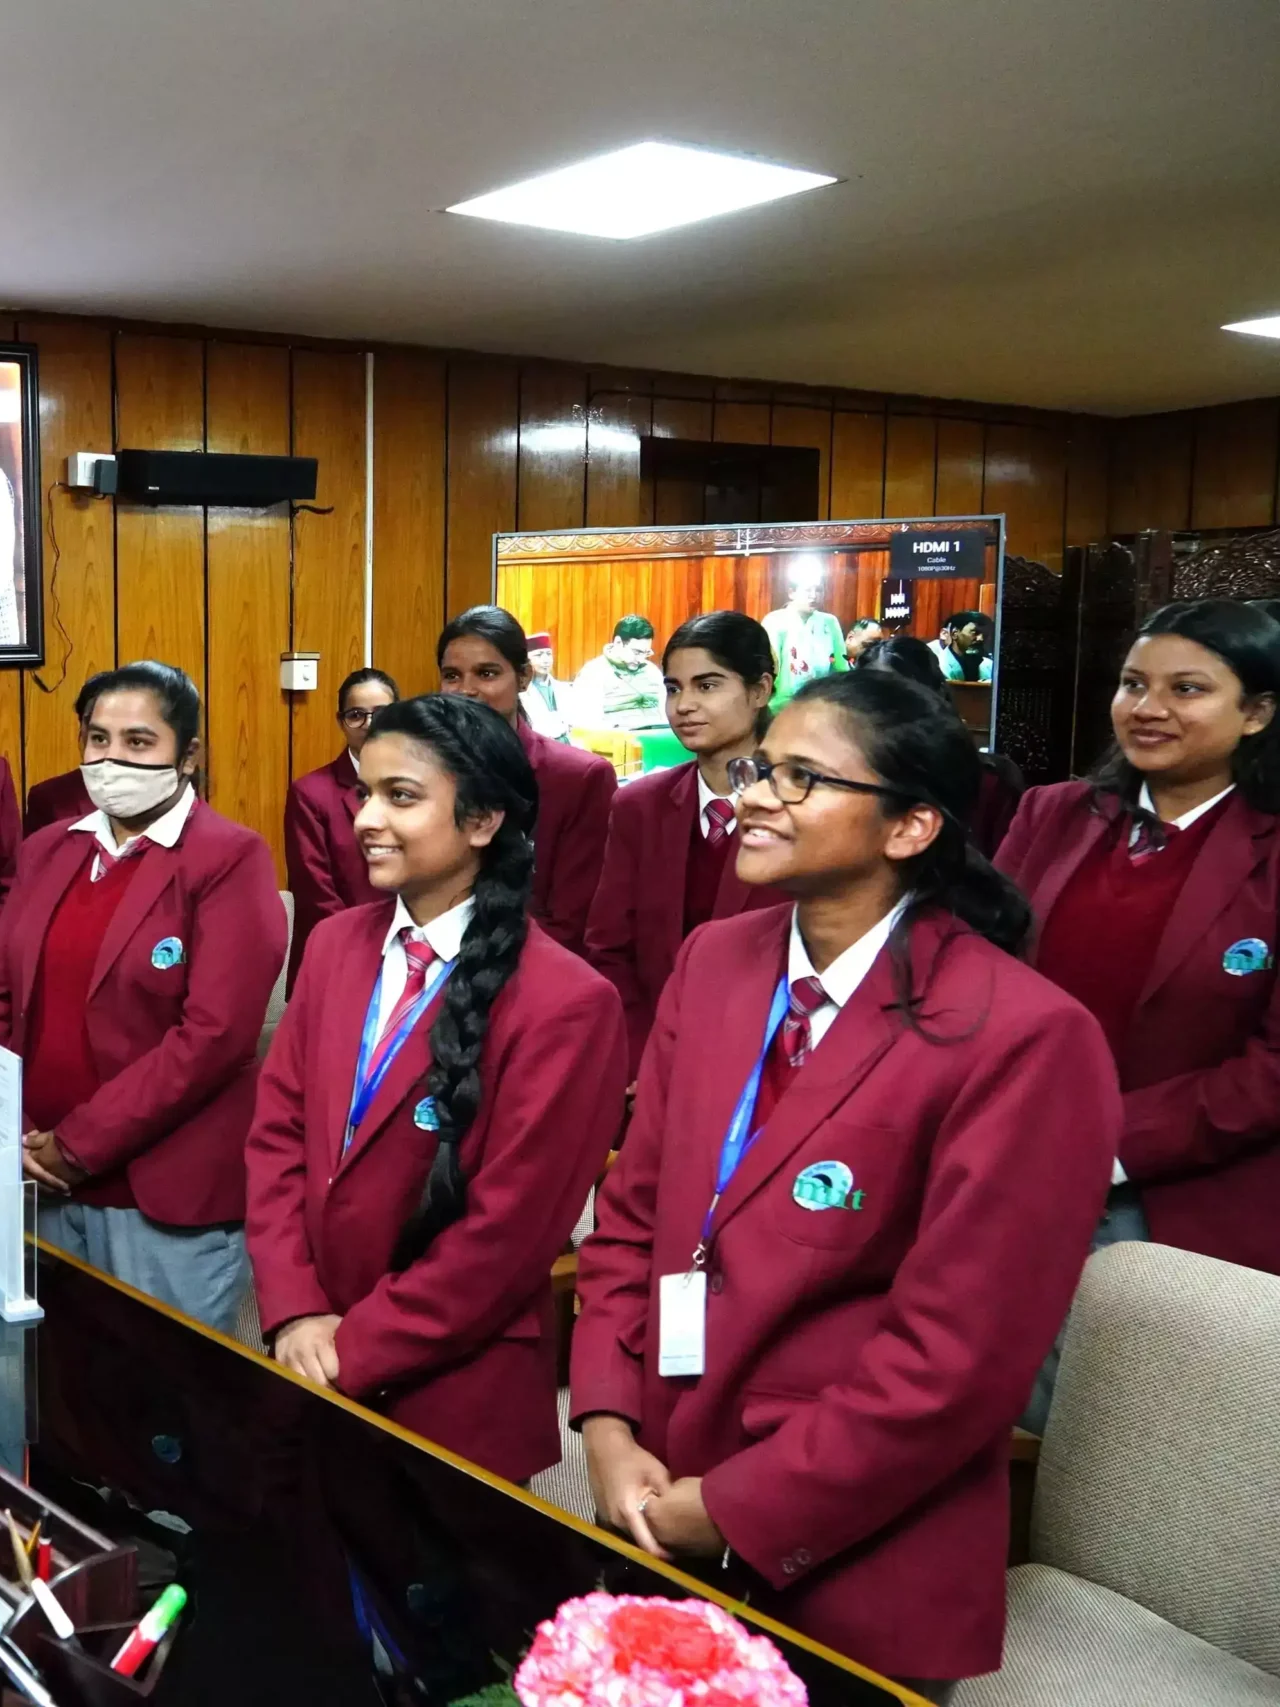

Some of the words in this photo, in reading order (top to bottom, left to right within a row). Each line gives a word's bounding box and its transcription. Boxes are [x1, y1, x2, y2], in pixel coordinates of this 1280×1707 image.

[913, 541, 950, 553] HDMI
[953, 540, 960, 552] 1
[795, 1178, 867, 1211] mit
